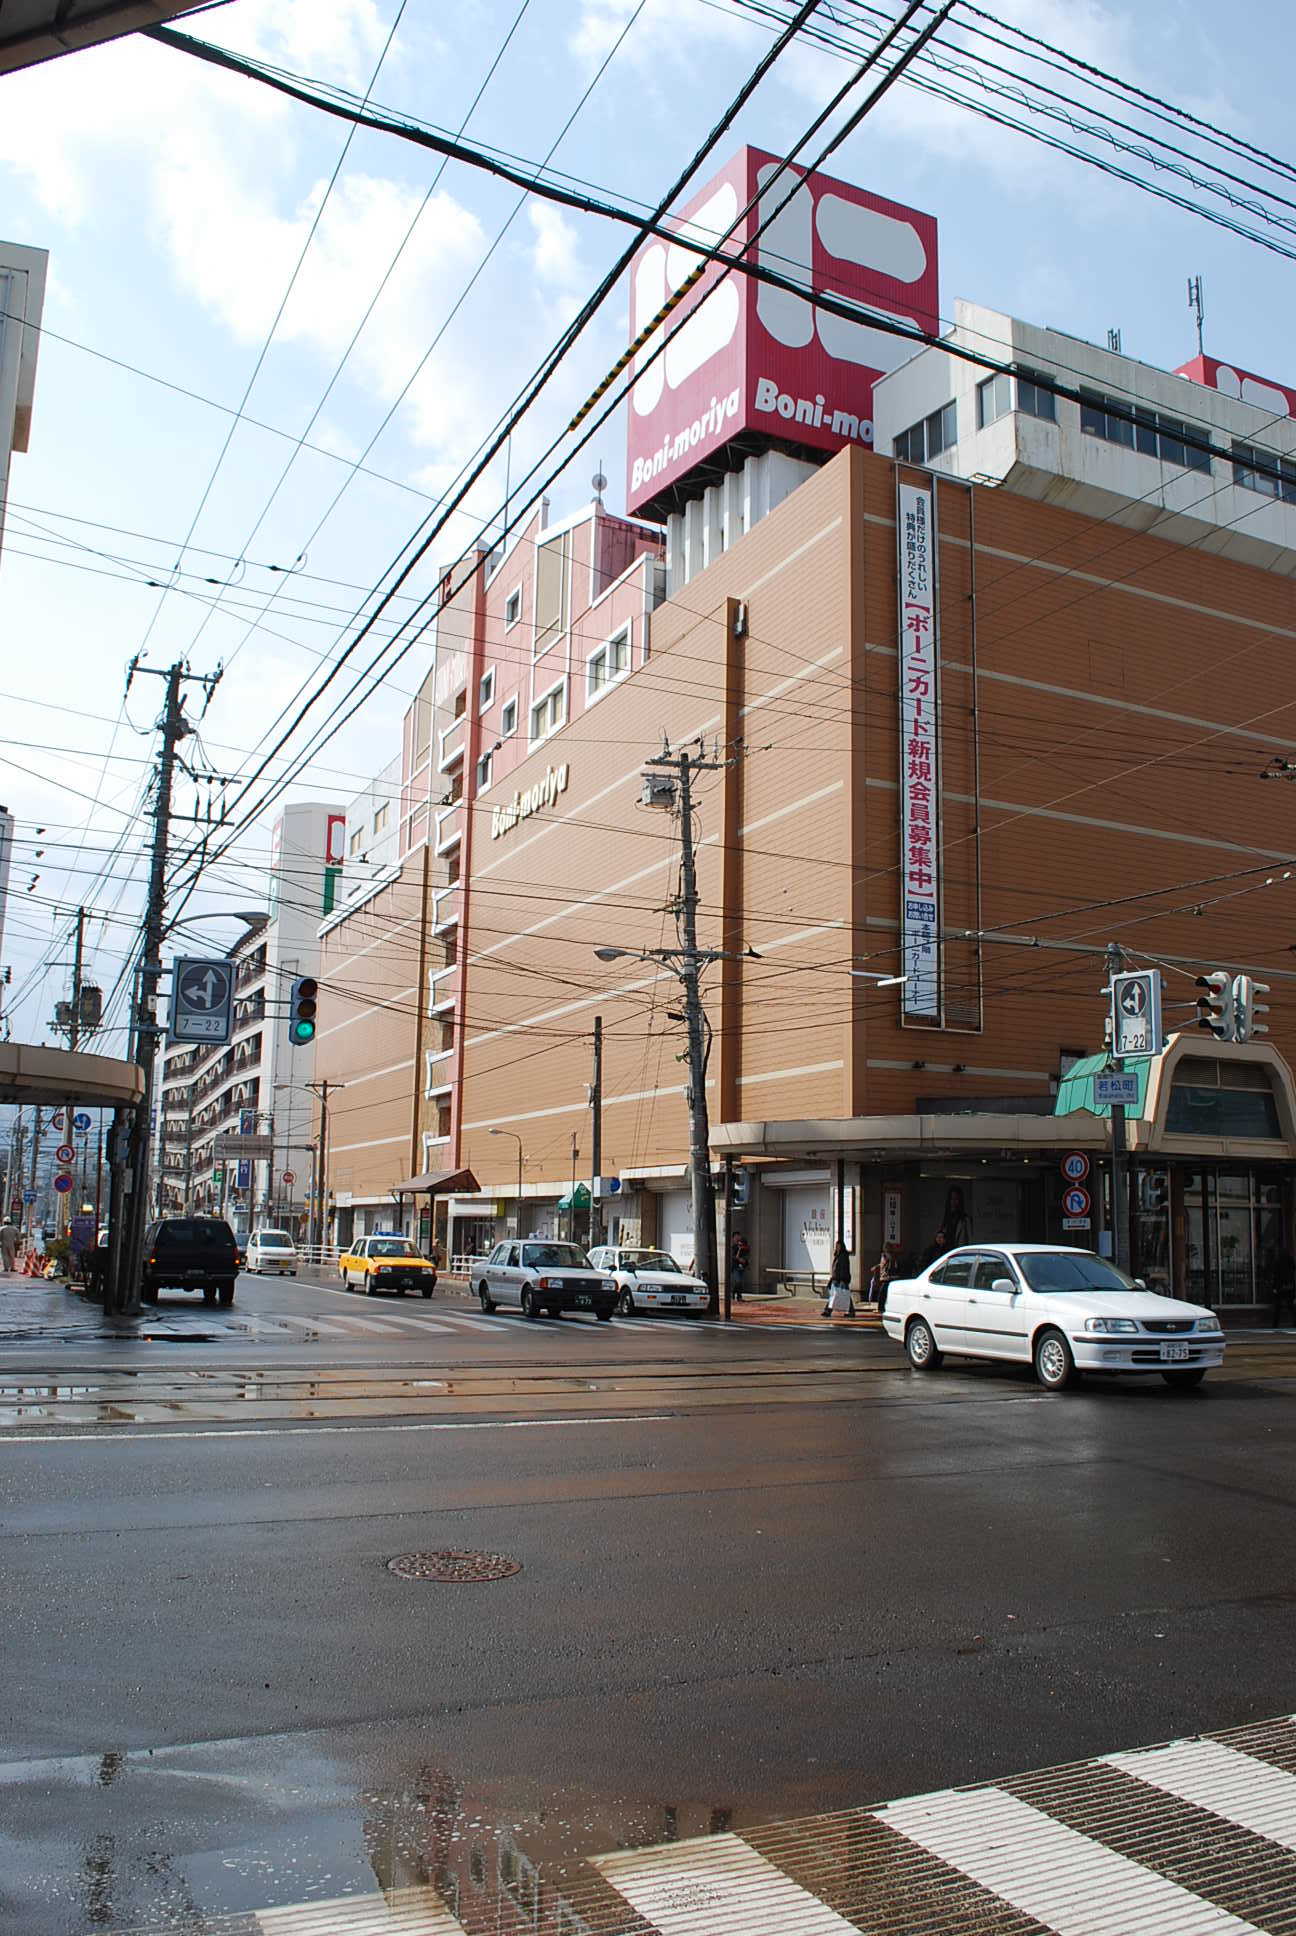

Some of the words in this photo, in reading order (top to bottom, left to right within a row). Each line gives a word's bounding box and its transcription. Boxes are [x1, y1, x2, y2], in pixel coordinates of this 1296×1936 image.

[630, 387, 741, 493] Boni-moriya
[491, 763, 569, 840] Boni-moriya
[1122, 1033, 1145, 1050] 7-22
[1098, 1080, 1134, 1092] 若松町
[1068, 1160, 1083, 1174] 40
